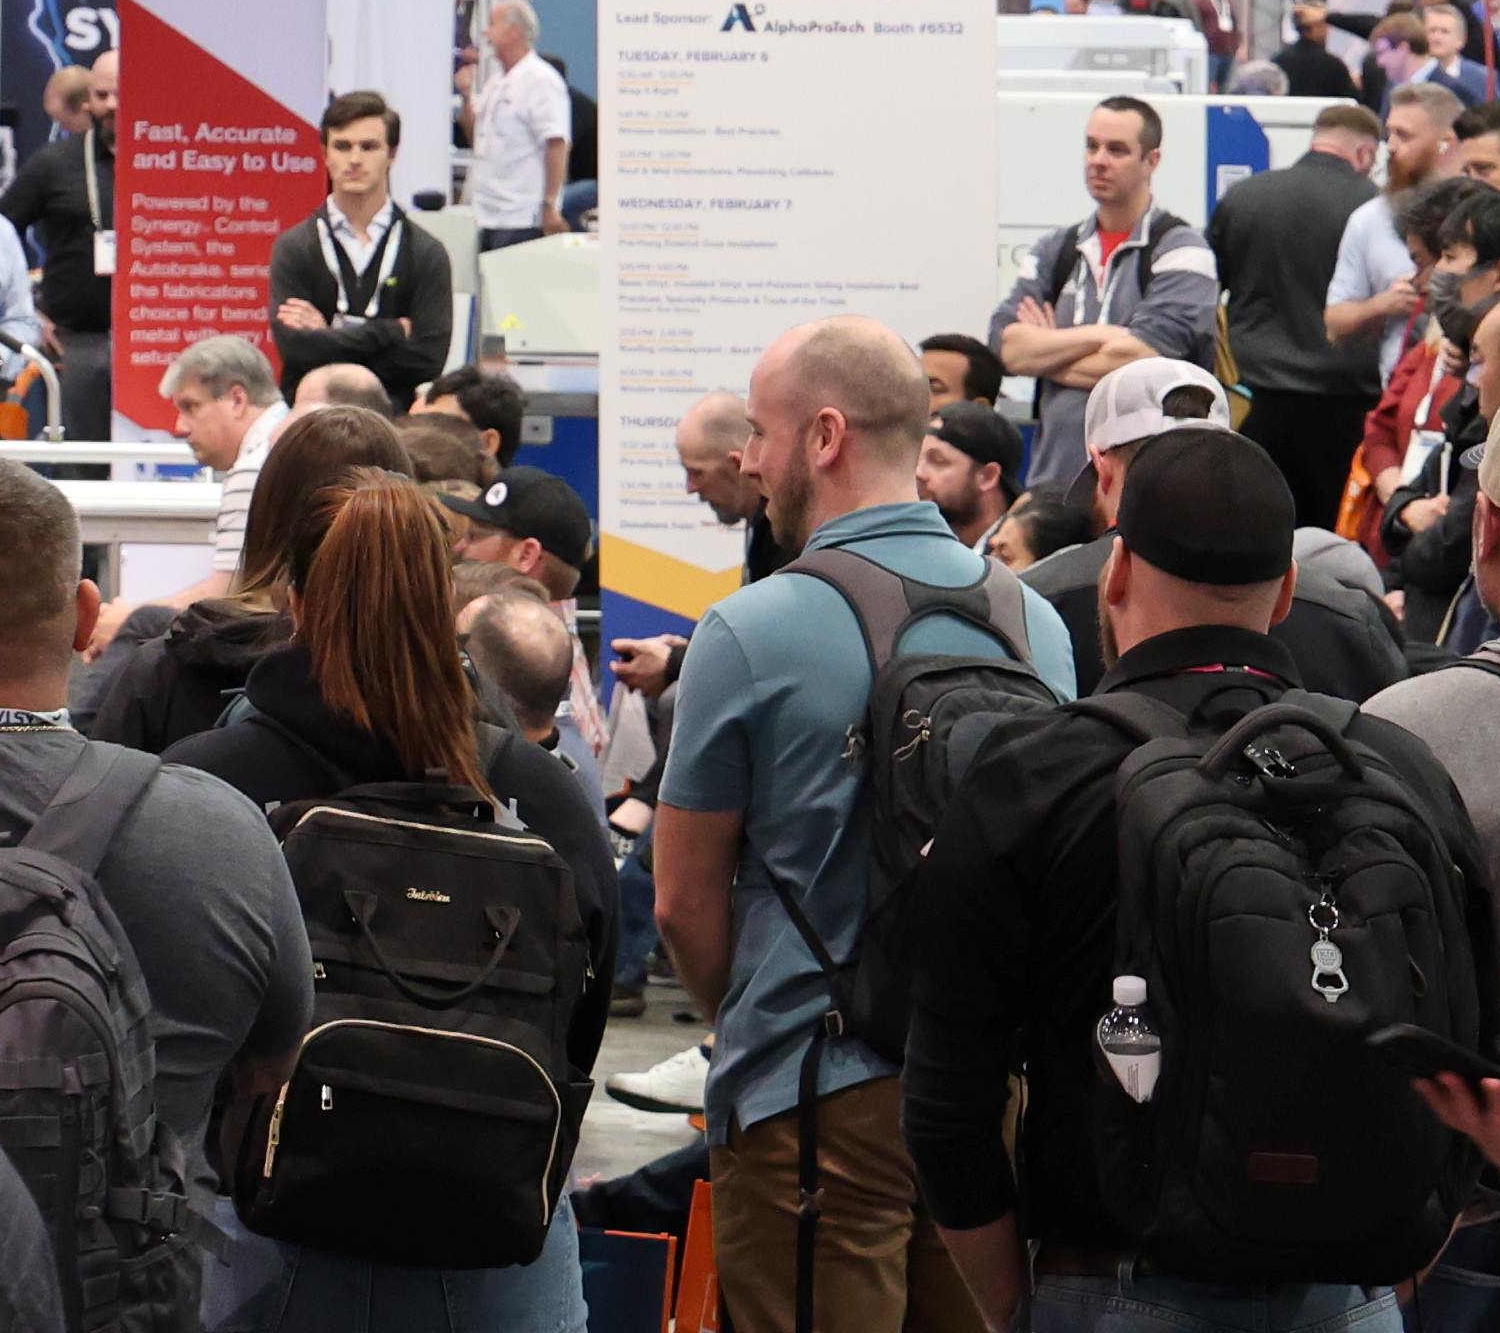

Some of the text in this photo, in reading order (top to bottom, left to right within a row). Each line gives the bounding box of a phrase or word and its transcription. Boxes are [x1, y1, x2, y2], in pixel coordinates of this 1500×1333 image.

[616, 12, 963, 36] Lead Sponsor: AlphaProTech Booth #6532
[618, 51, 683, 63] TUESDAY,
[687, 51, 756, 62] FEBRUARY
[134, 121, 298, 145] Fast, Accurate
[133, 149, 317, 175] and Easy to Use
[132, 193, 268, 215] Powered by the
[618, 198, 706, 210] WEDNESDAY,
[710, 198, 780, 210] FEBRUARY
[214, 217, 280, 233] Control
[131, 238, 235, 260] System, the
[130, 283, 257, 300] the fabricators
[129, 305, 189, 321] choice
[194, 306, 217, 321] for
[130, 327, 180, 343] metal
